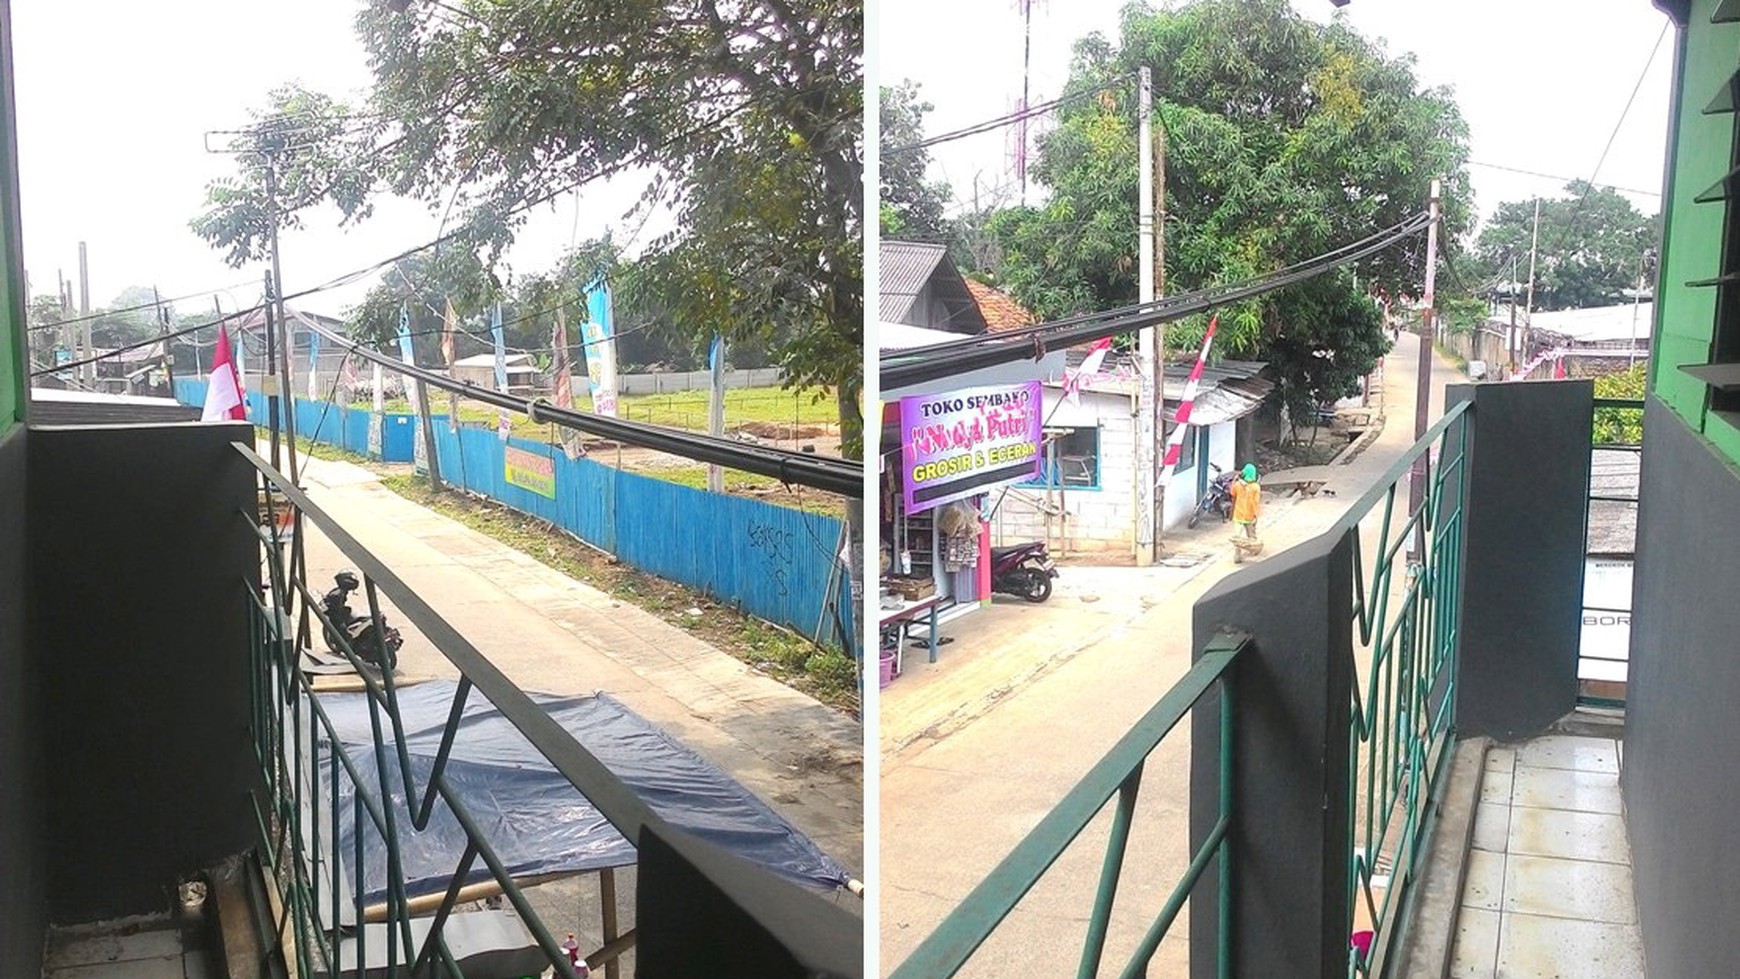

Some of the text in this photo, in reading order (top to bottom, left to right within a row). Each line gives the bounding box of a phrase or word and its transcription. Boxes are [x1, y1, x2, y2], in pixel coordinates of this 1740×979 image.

[921, 390, 1029, 417] TOKO SEMBAKO
[912, 456, 973, 483] GROSIR
[975, 452, 985, 467] &
